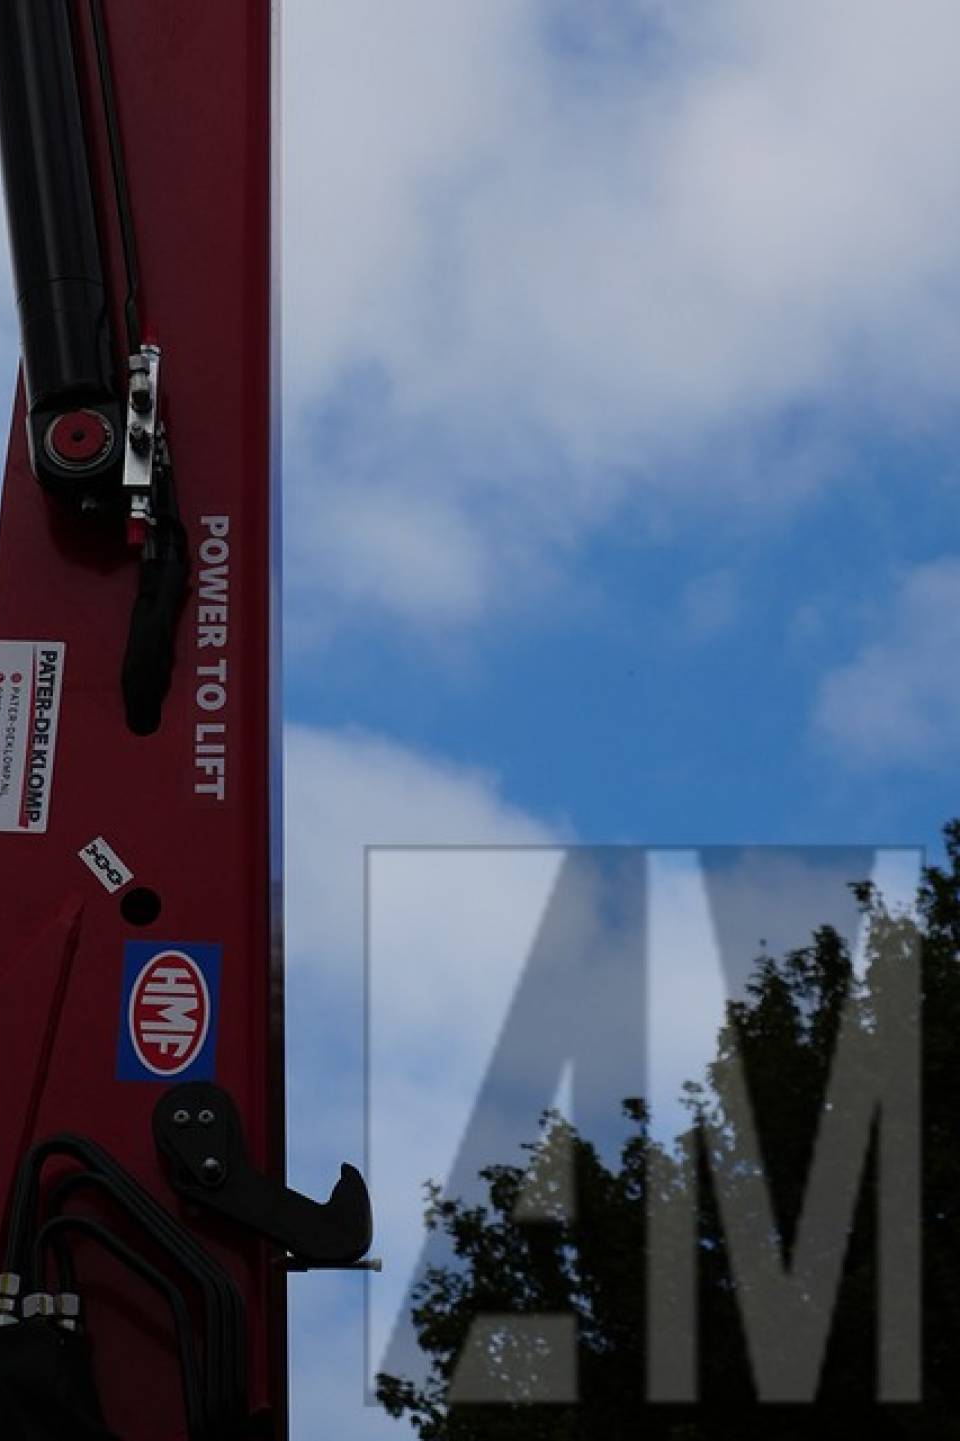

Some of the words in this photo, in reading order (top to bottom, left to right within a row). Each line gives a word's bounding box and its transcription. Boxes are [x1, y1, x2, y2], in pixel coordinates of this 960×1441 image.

[196, 515, 230, 649] POWER
[196, 659, 227, 711] TO
[26, 749, 49, 823] KLOMP
[194, 722, 226, 801] LIFT
[140, 967, 198, 1057] HMF
